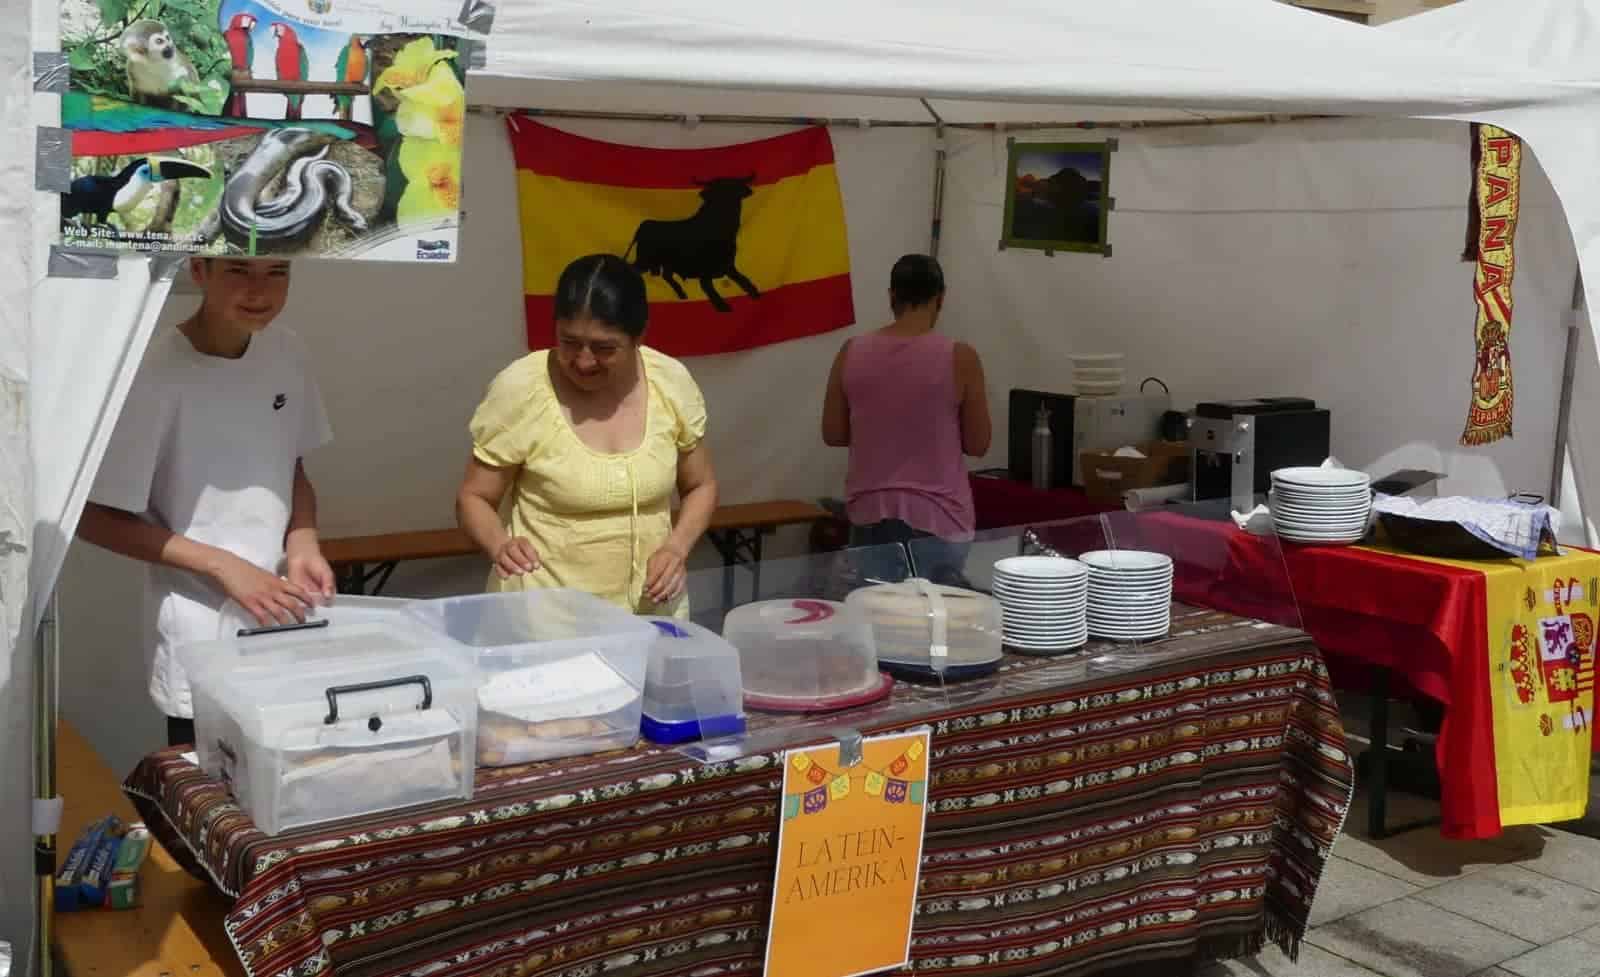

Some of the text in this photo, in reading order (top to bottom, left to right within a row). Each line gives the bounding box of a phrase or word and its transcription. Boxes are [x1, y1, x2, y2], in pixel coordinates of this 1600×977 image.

[63, 226, 88, 238] Web
[91, 227, 116, 239] Site:
[797, 824, 905, 869] LATEIN-
[784, 856, 909, 904] AMERIKA
